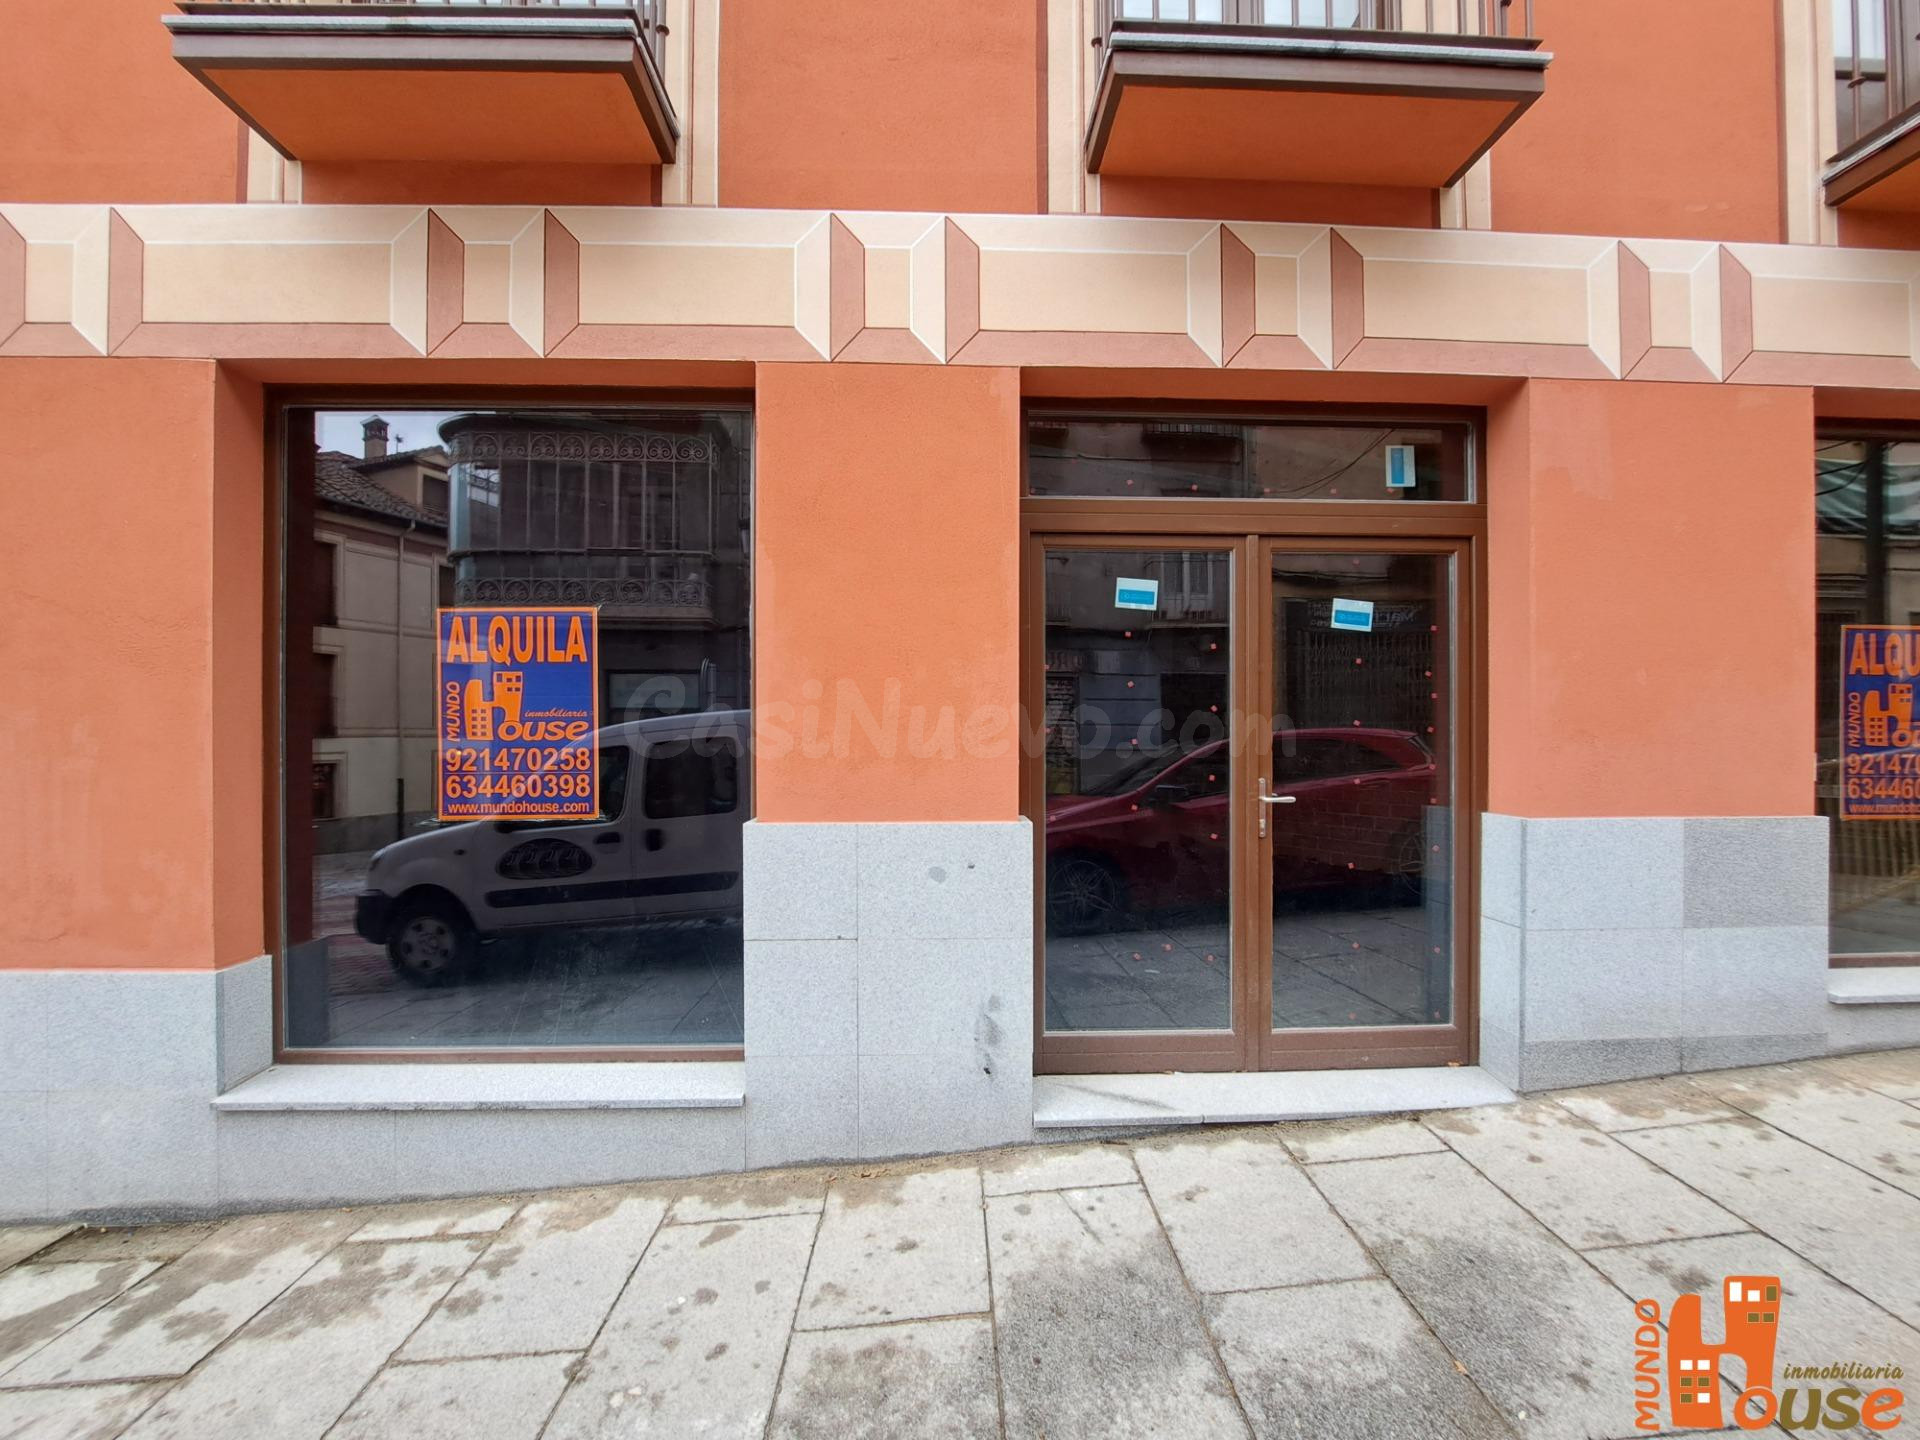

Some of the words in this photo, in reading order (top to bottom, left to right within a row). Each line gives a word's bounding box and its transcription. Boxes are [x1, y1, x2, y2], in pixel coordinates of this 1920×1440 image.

[446, 615, 588, 666] ALQUILA
[446, 681, 460, 742] MUNDO
[524, 707, 588, 718] inmobiliaria
[1848, 692, 1861, 747] MUNDO
[446, 748, 591, 771] 921470258
[446, 774, 591, 798] 634460398
[448, 802, 589, 814] www.mundohouse.com
